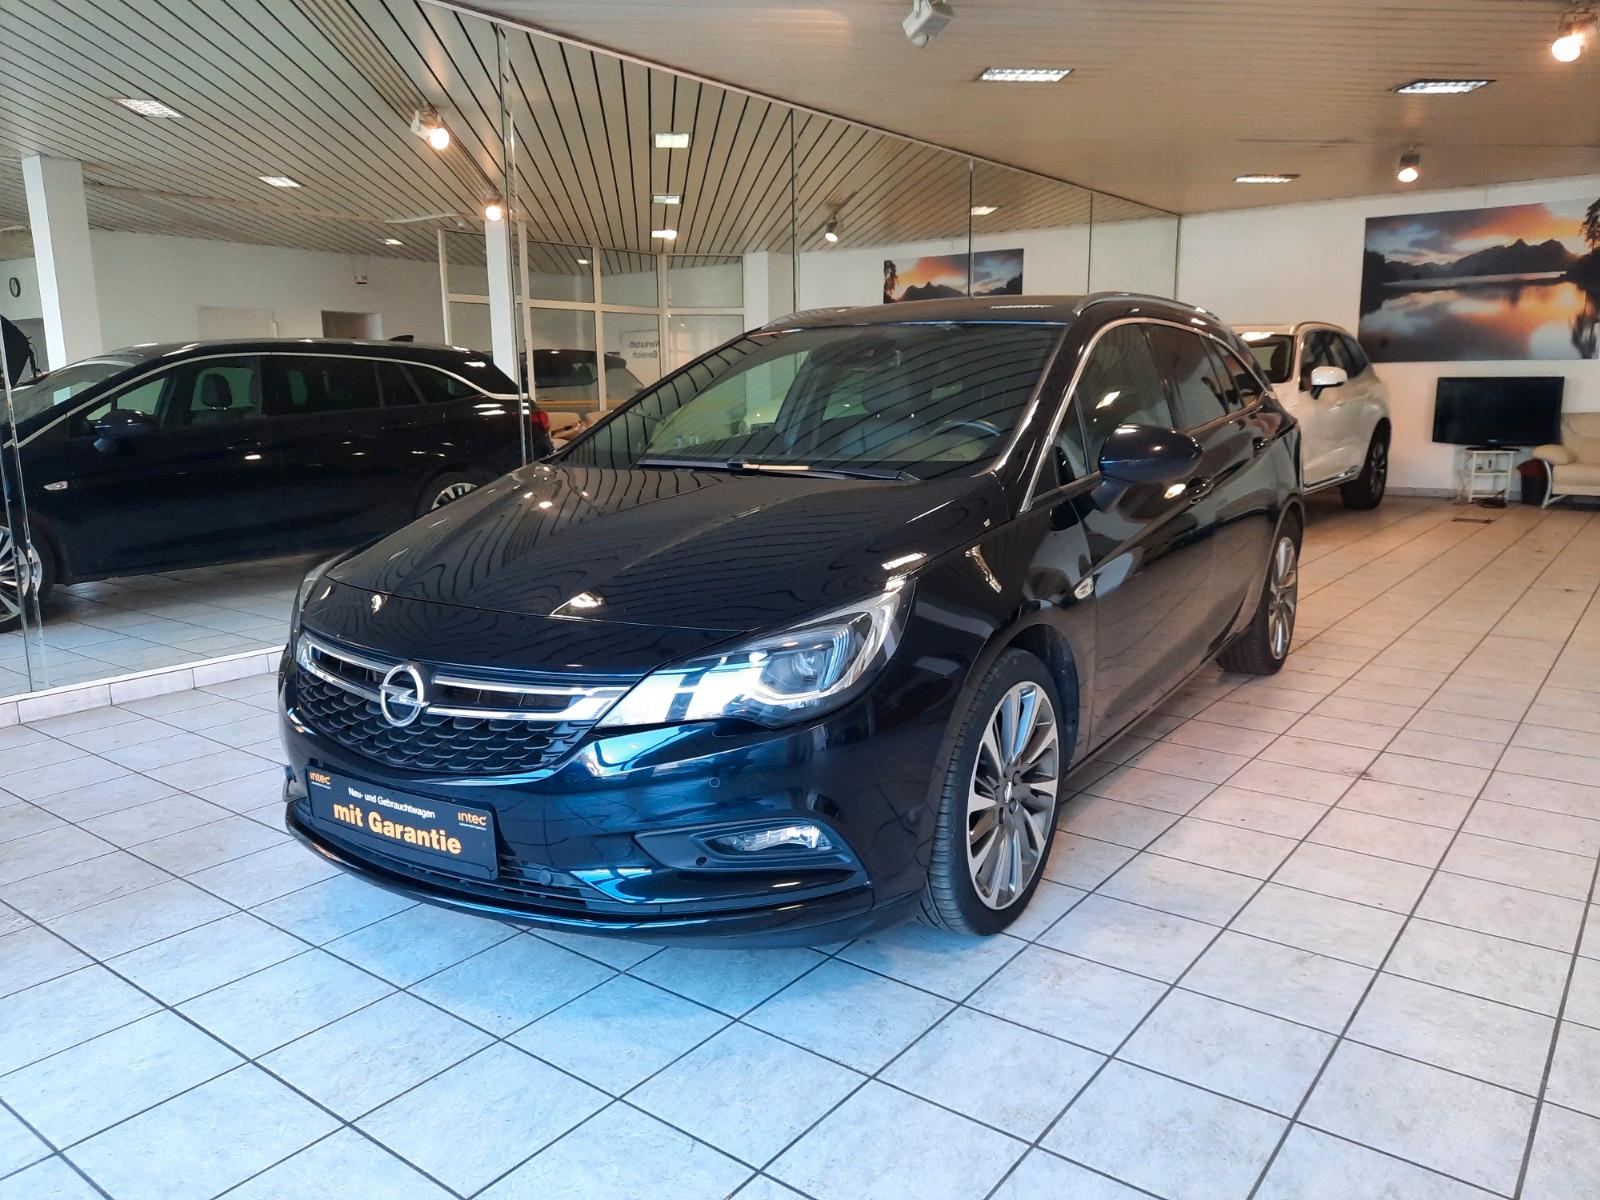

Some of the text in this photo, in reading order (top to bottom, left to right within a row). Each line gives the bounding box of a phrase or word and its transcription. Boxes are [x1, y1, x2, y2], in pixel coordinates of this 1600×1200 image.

[309, 771, 331, 785] intec
[364, 793, 377, 804] und
[377, 795, 436, 819] Gebrauchtwagen
[457, 811, 487, 826] intec
[333, 803, 462, 855] mit Garantie
